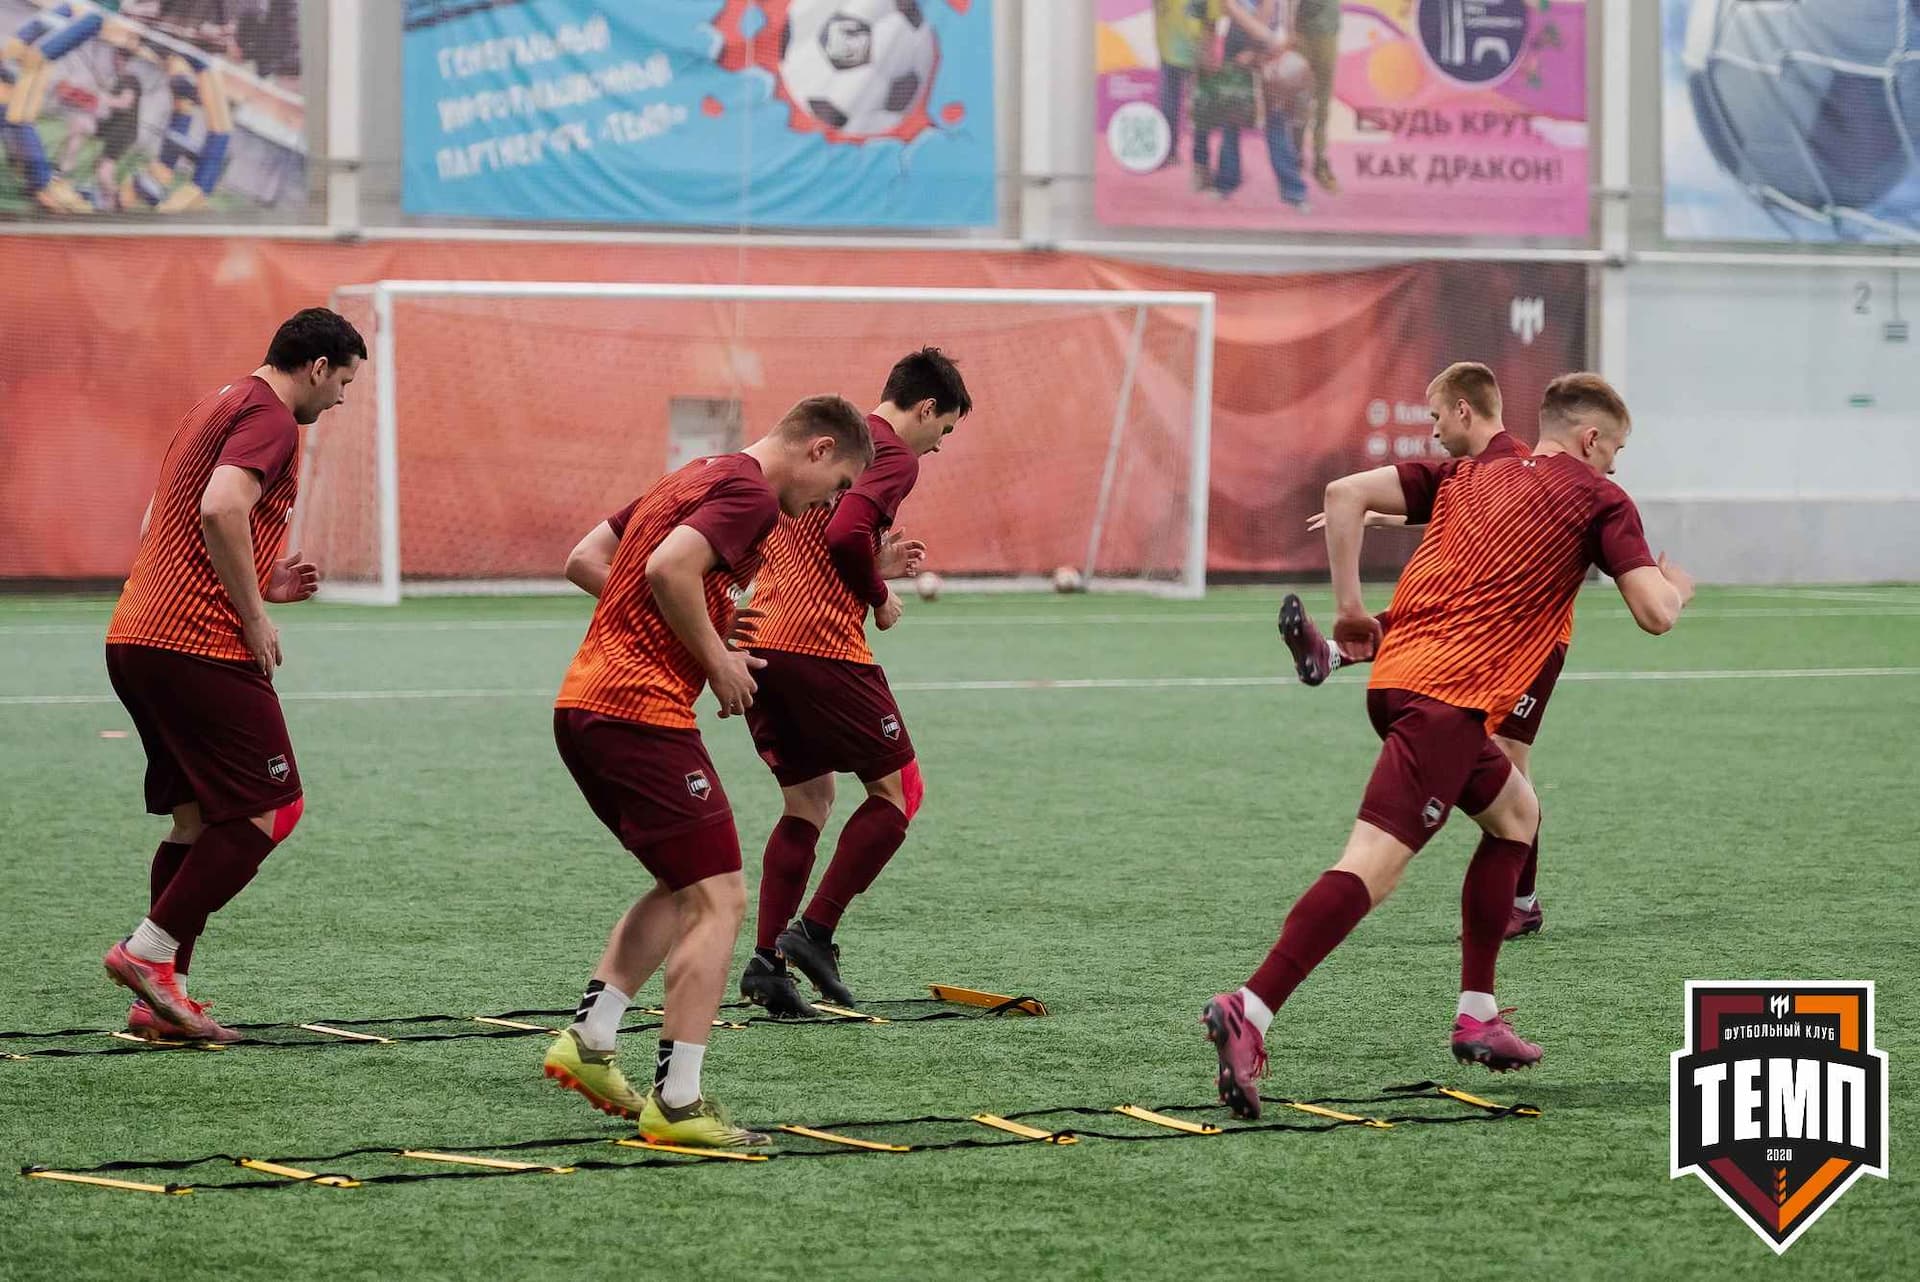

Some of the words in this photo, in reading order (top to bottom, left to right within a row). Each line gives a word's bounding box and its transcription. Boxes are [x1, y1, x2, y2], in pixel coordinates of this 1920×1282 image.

[1356, 109, 1452, 137] БУДЬ
[1356, 153, 1417, 178] КАК
[1425, 154, 1563, 185] ДРАКОН!
[1854, 281, 1871, 315] 2
[1512, 694, 1537, 718] 27
